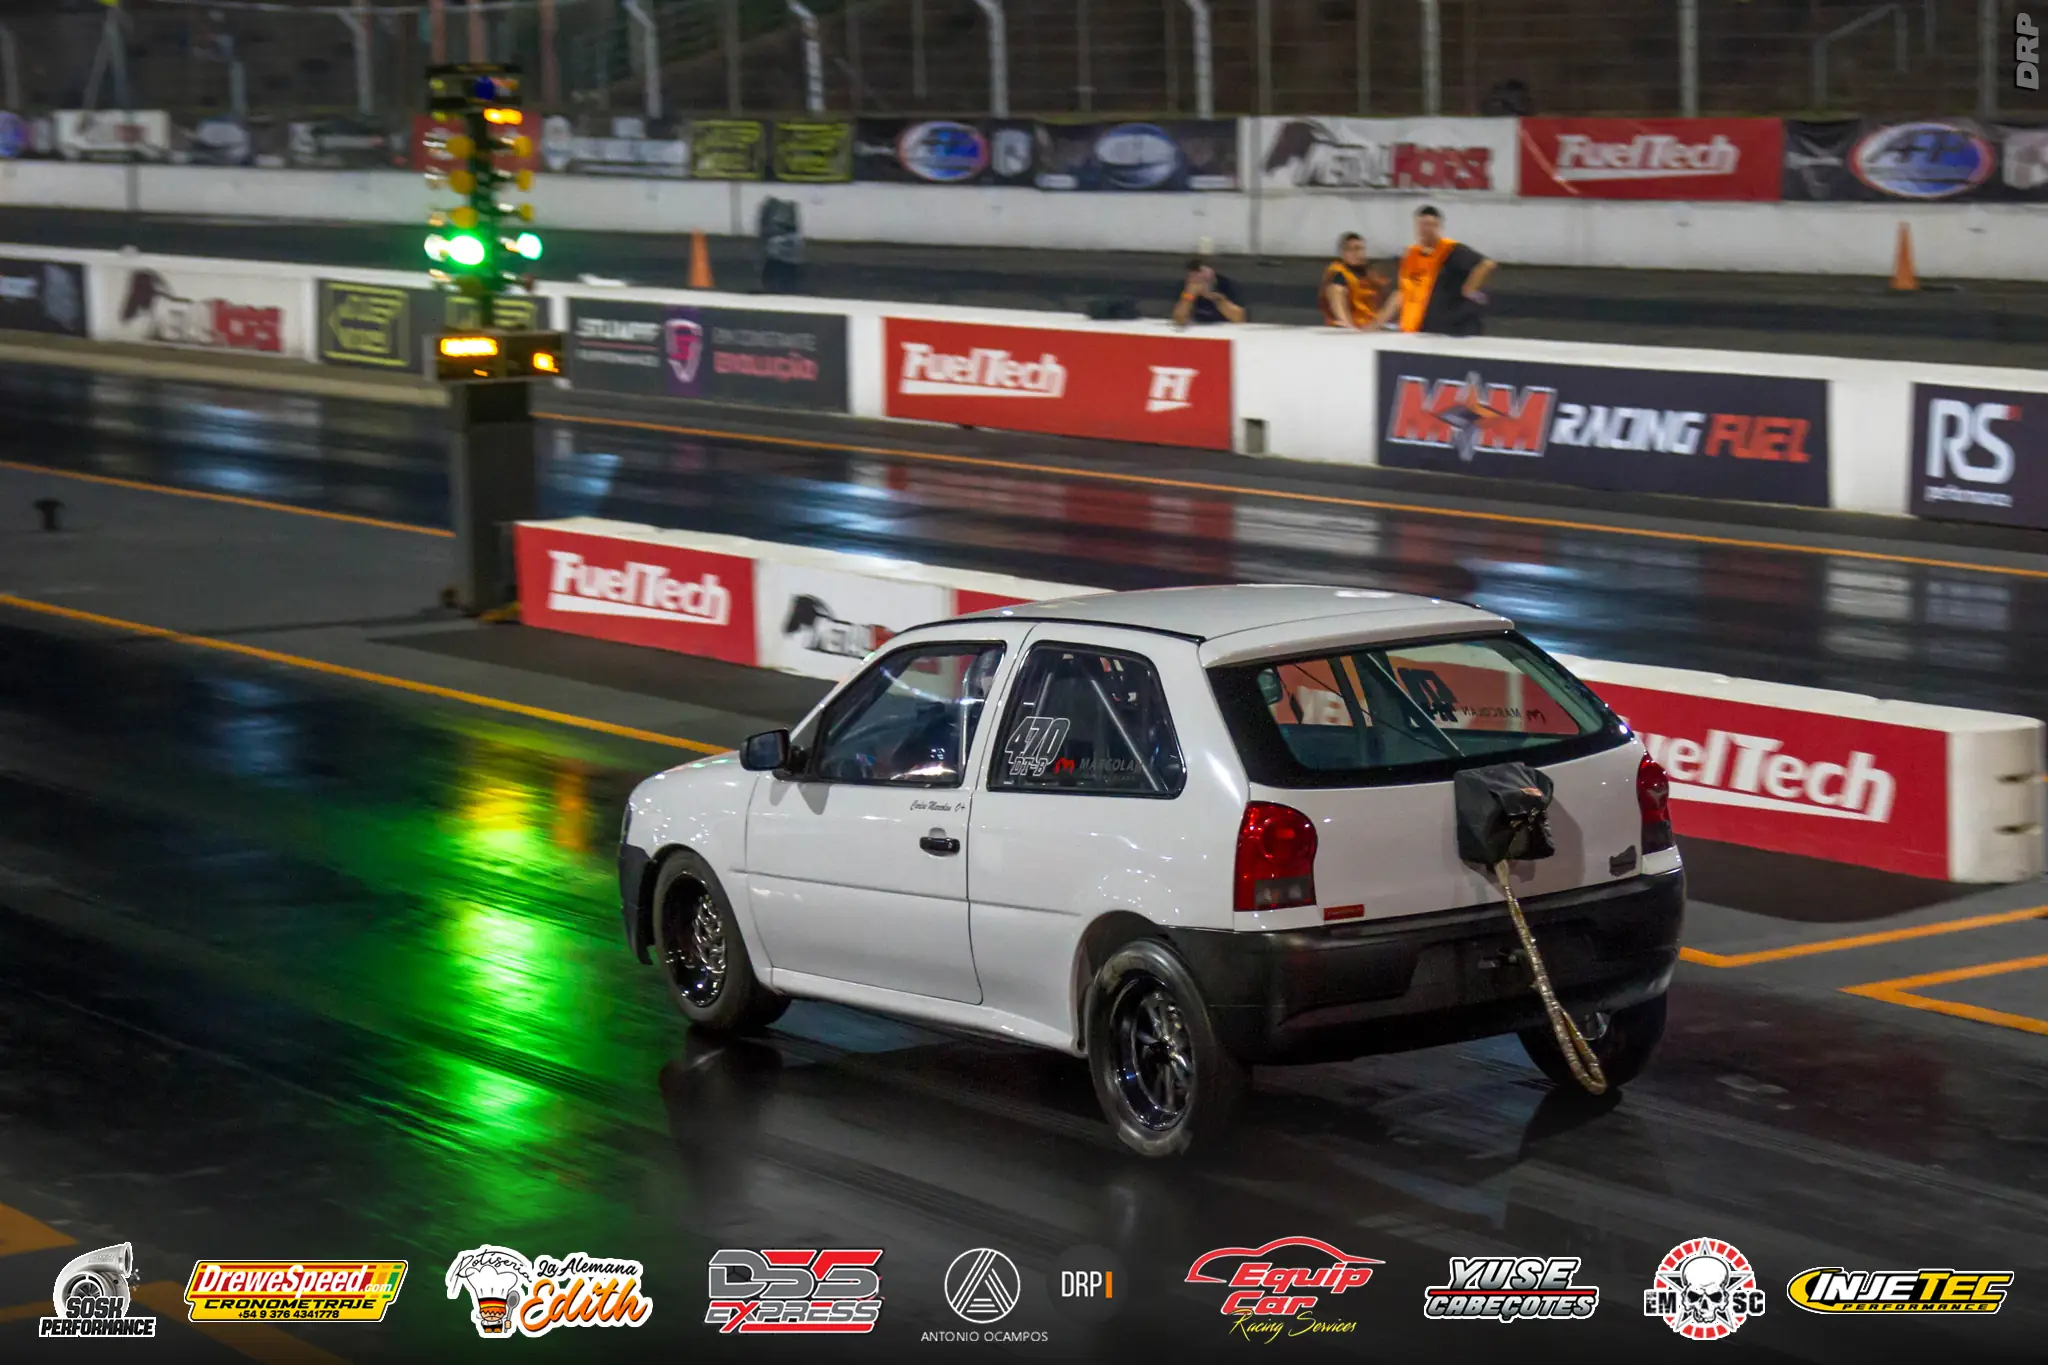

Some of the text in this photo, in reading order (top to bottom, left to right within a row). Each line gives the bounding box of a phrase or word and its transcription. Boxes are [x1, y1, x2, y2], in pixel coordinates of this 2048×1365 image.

[1556, 134, 1741, 176] FuelTech
[901, 342, 1067, 398] FuelTech
[1550, 402, 1706, 455] RACING
[1705, 413, 1811, 462] FUEL
[1925, 398, 2020, 484] RS
[547, 550, 731, 625] FuelTech
[1005, 716, 1070, 766] 470
[1634, 728, 1896, 823] uelTech
